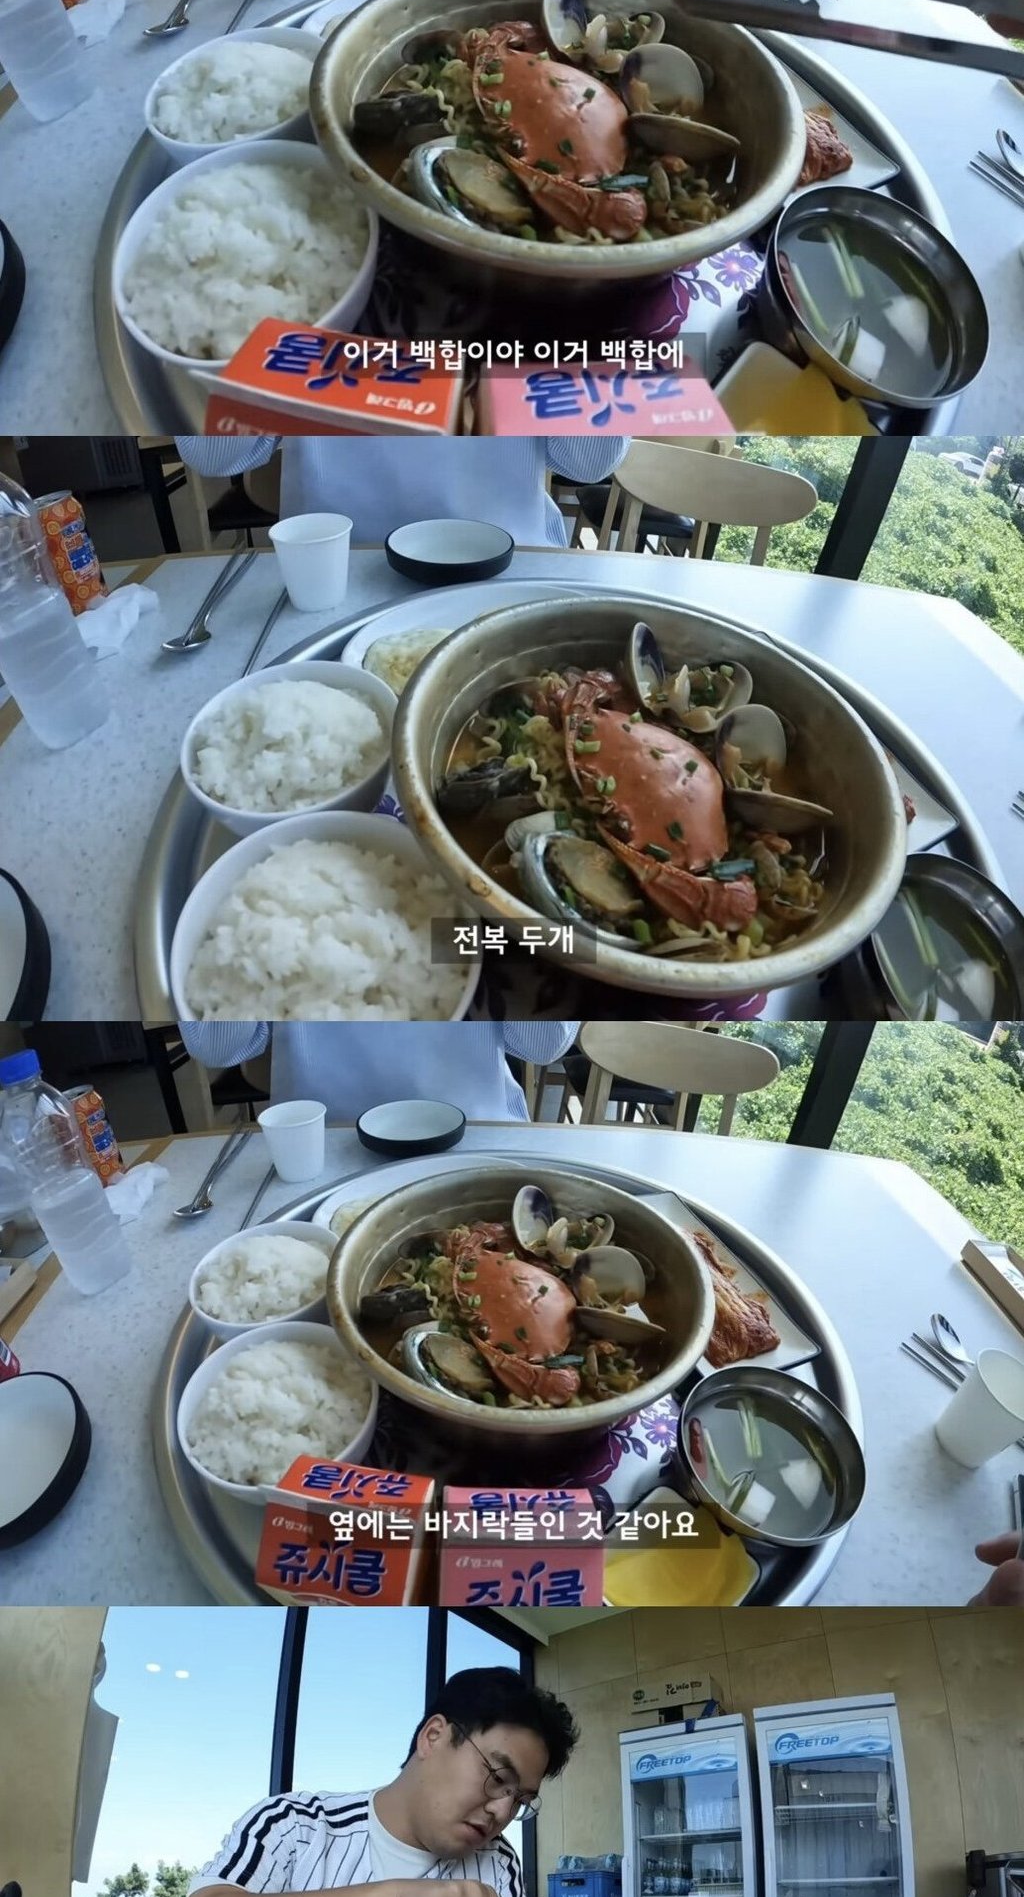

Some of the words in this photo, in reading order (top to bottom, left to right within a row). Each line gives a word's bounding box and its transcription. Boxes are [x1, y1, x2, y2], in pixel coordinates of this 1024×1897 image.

[303, 1463, 412, 1499] 쥬시쿨
[273, 1542, 387, 1596] 쥬시쿨
[778, 1735, 840, 1752] FREETOP
